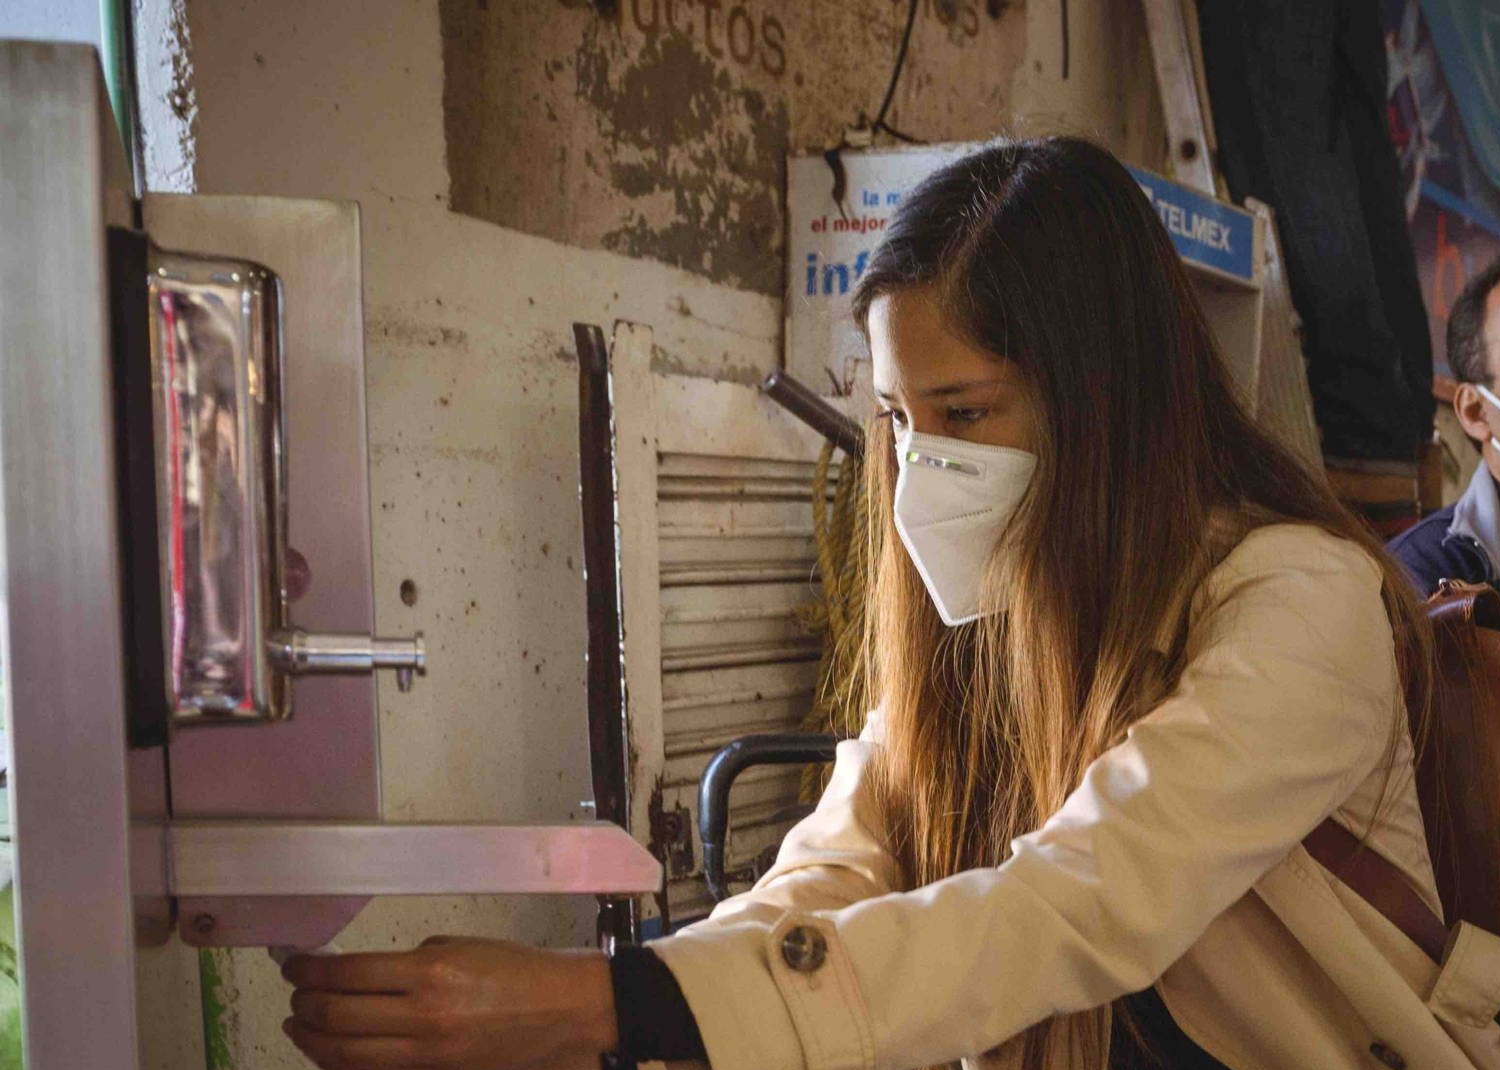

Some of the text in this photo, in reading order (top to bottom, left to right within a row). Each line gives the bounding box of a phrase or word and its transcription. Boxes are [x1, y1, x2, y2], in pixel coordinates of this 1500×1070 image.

[862, 189, 880, 207] la
[810, 215, 886, 234] el mejor
[1155, 199, 1233, 254] TELMEX
